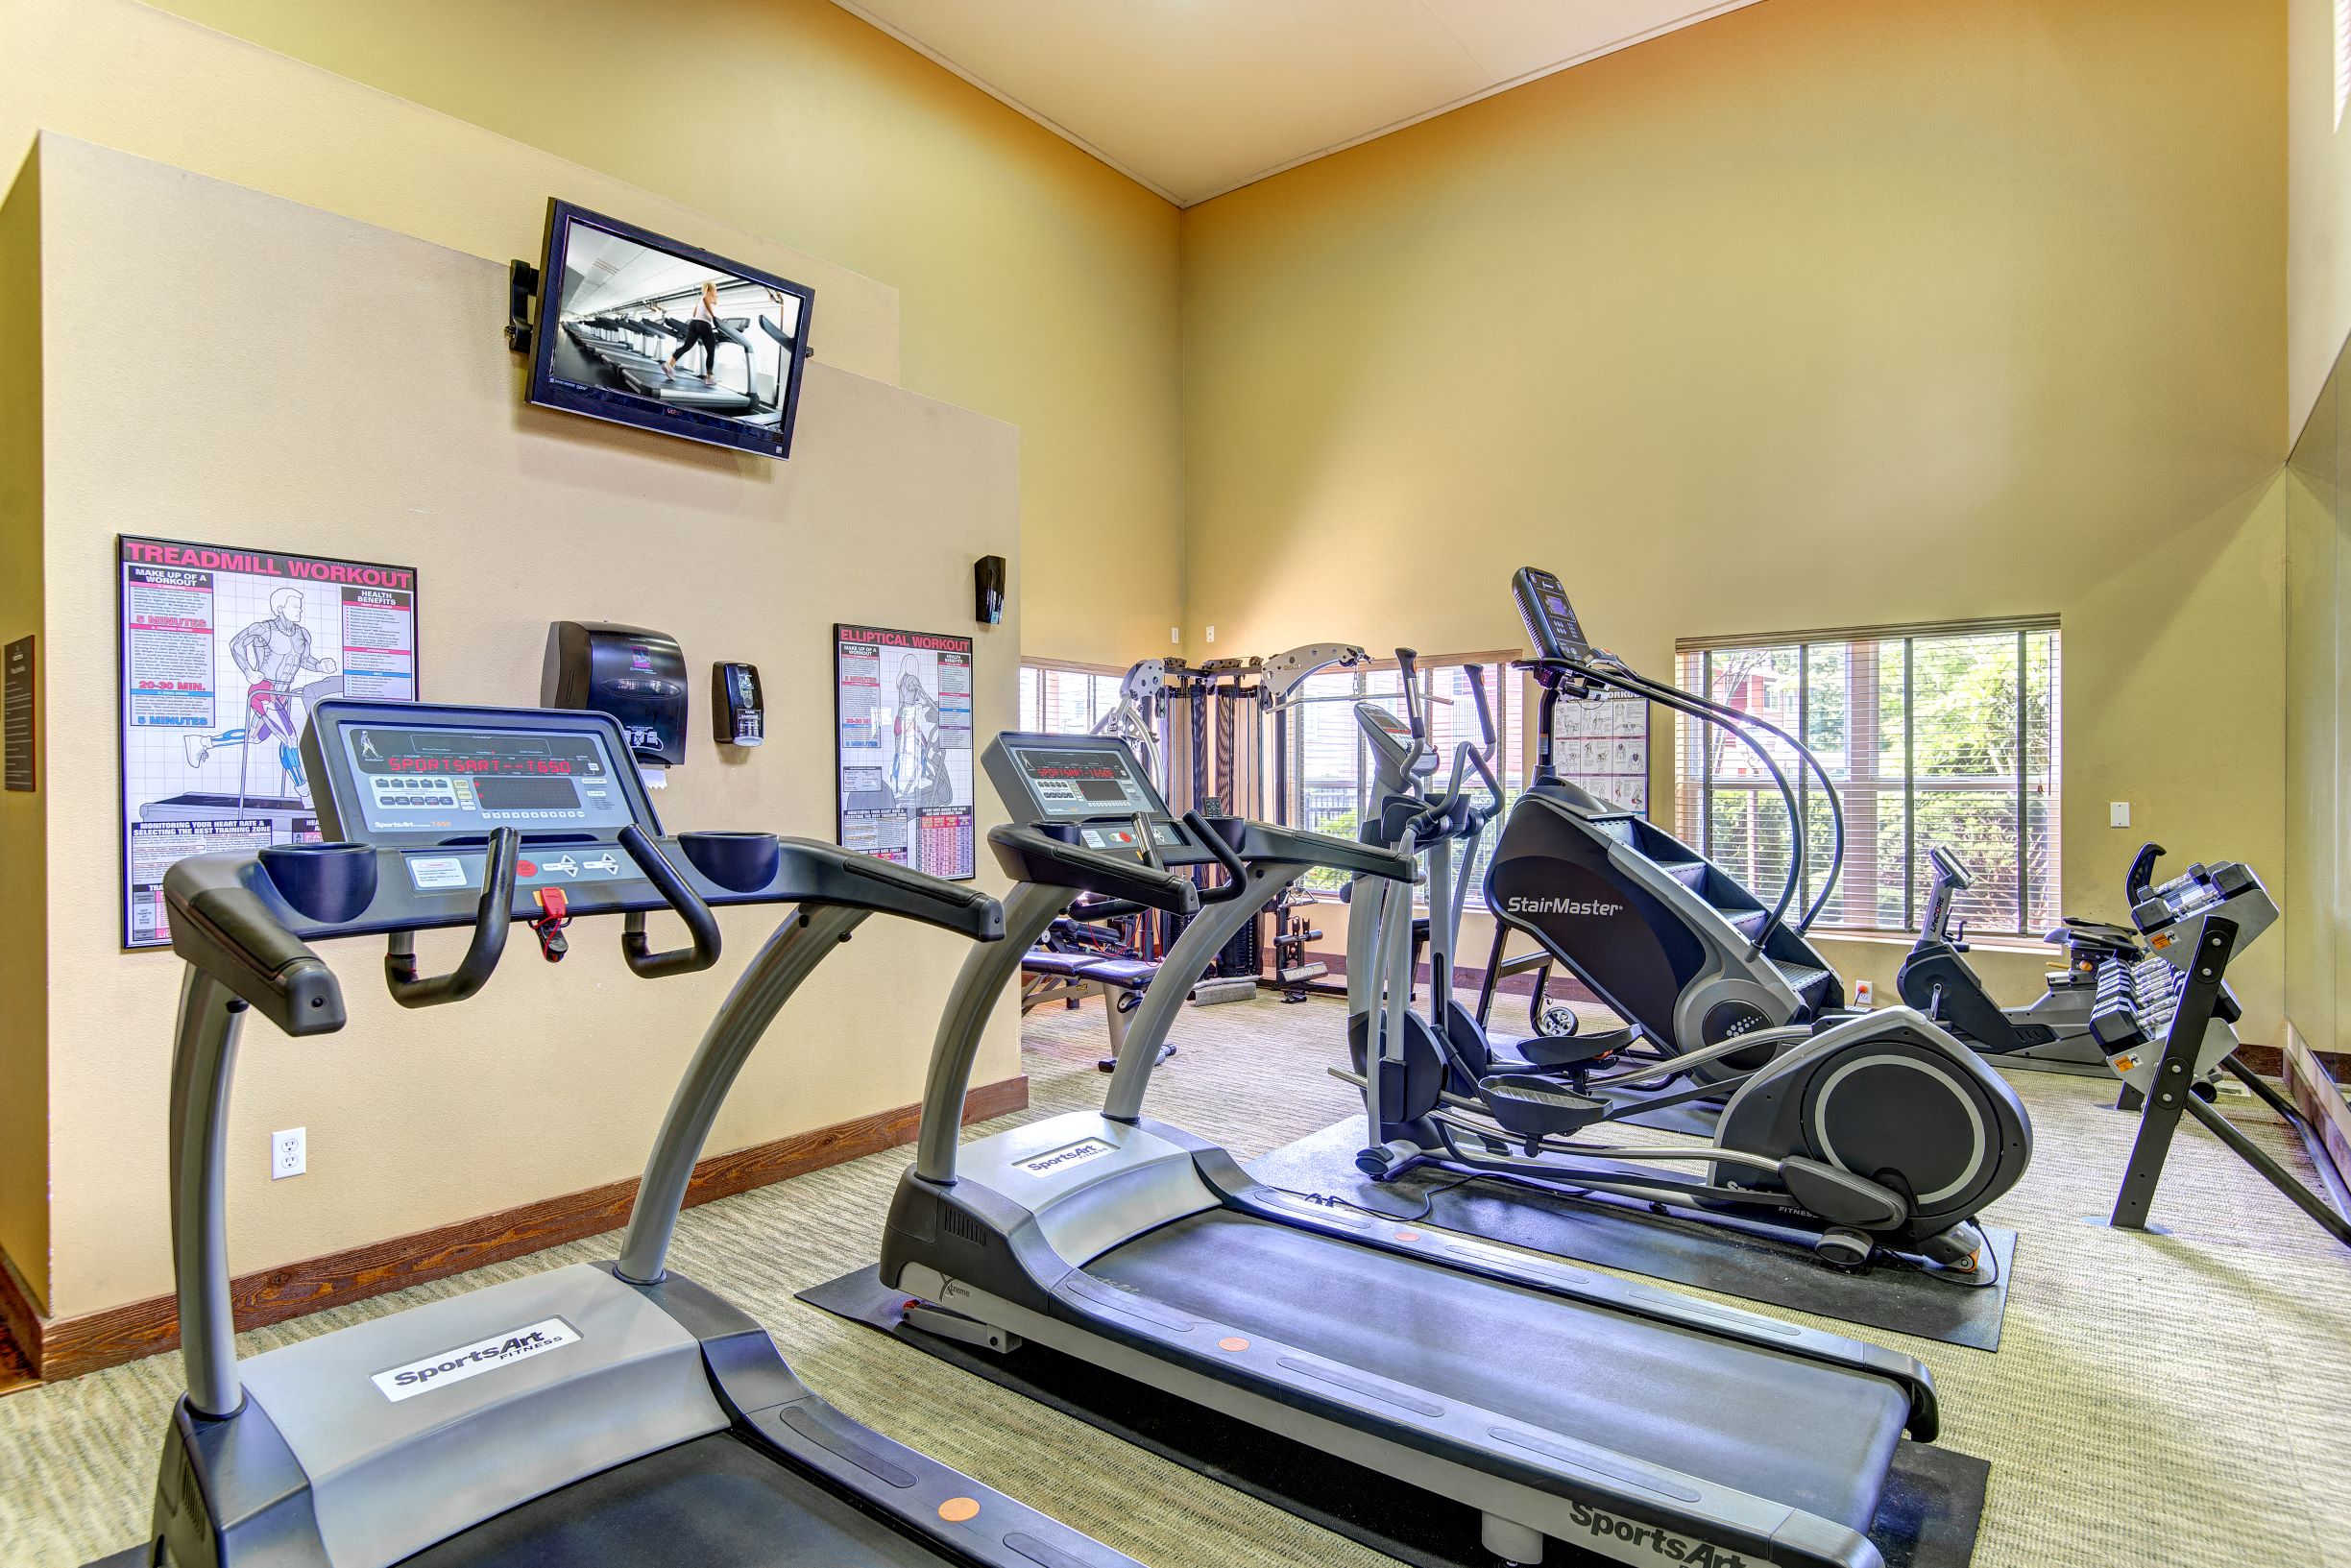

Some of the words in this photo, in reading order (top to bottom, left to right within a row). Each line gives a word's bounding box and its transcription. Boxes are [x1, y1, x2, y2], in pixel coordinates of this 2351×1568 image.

[126, 543, 281, 575] TREADMILL
[288, 560, 411, 589] WORKOUT
[134, 568, 165, 578] MAKE
[183, 572, 197, 581] OF
[146, 576, 197, 587] WORKOUT
[357, 595, 397, 606] BENEFITS
[361, 590, 392, 599] HEALTH
[136, 615, 145, 623] 5
[147, 615, 206, 627] MINUTES
[840, 629, 909, 646] ELLIPTICAL
[912, 636, 969, 652] WORKOUT
[138, 681, 174, 690] 20-30
[177, 681, 206, 691] MIN.
[137, 715, 146, 724] 5
[149, 715, 208, 726] MINUTES
[1507, 897, 1619, 916] StairMaster
[1930, 896, 1945, 932] LifeCORE
[1028, 1145, 1097, 1171] SportsArt
[1079, 1147, 1108, 1160] FITNESS
[499, 1336, 563, 1360] FITNESS
[394, 1331, 545, 1386] SportsArt
[1568, 1499, 1747, 1568] SportsArt
